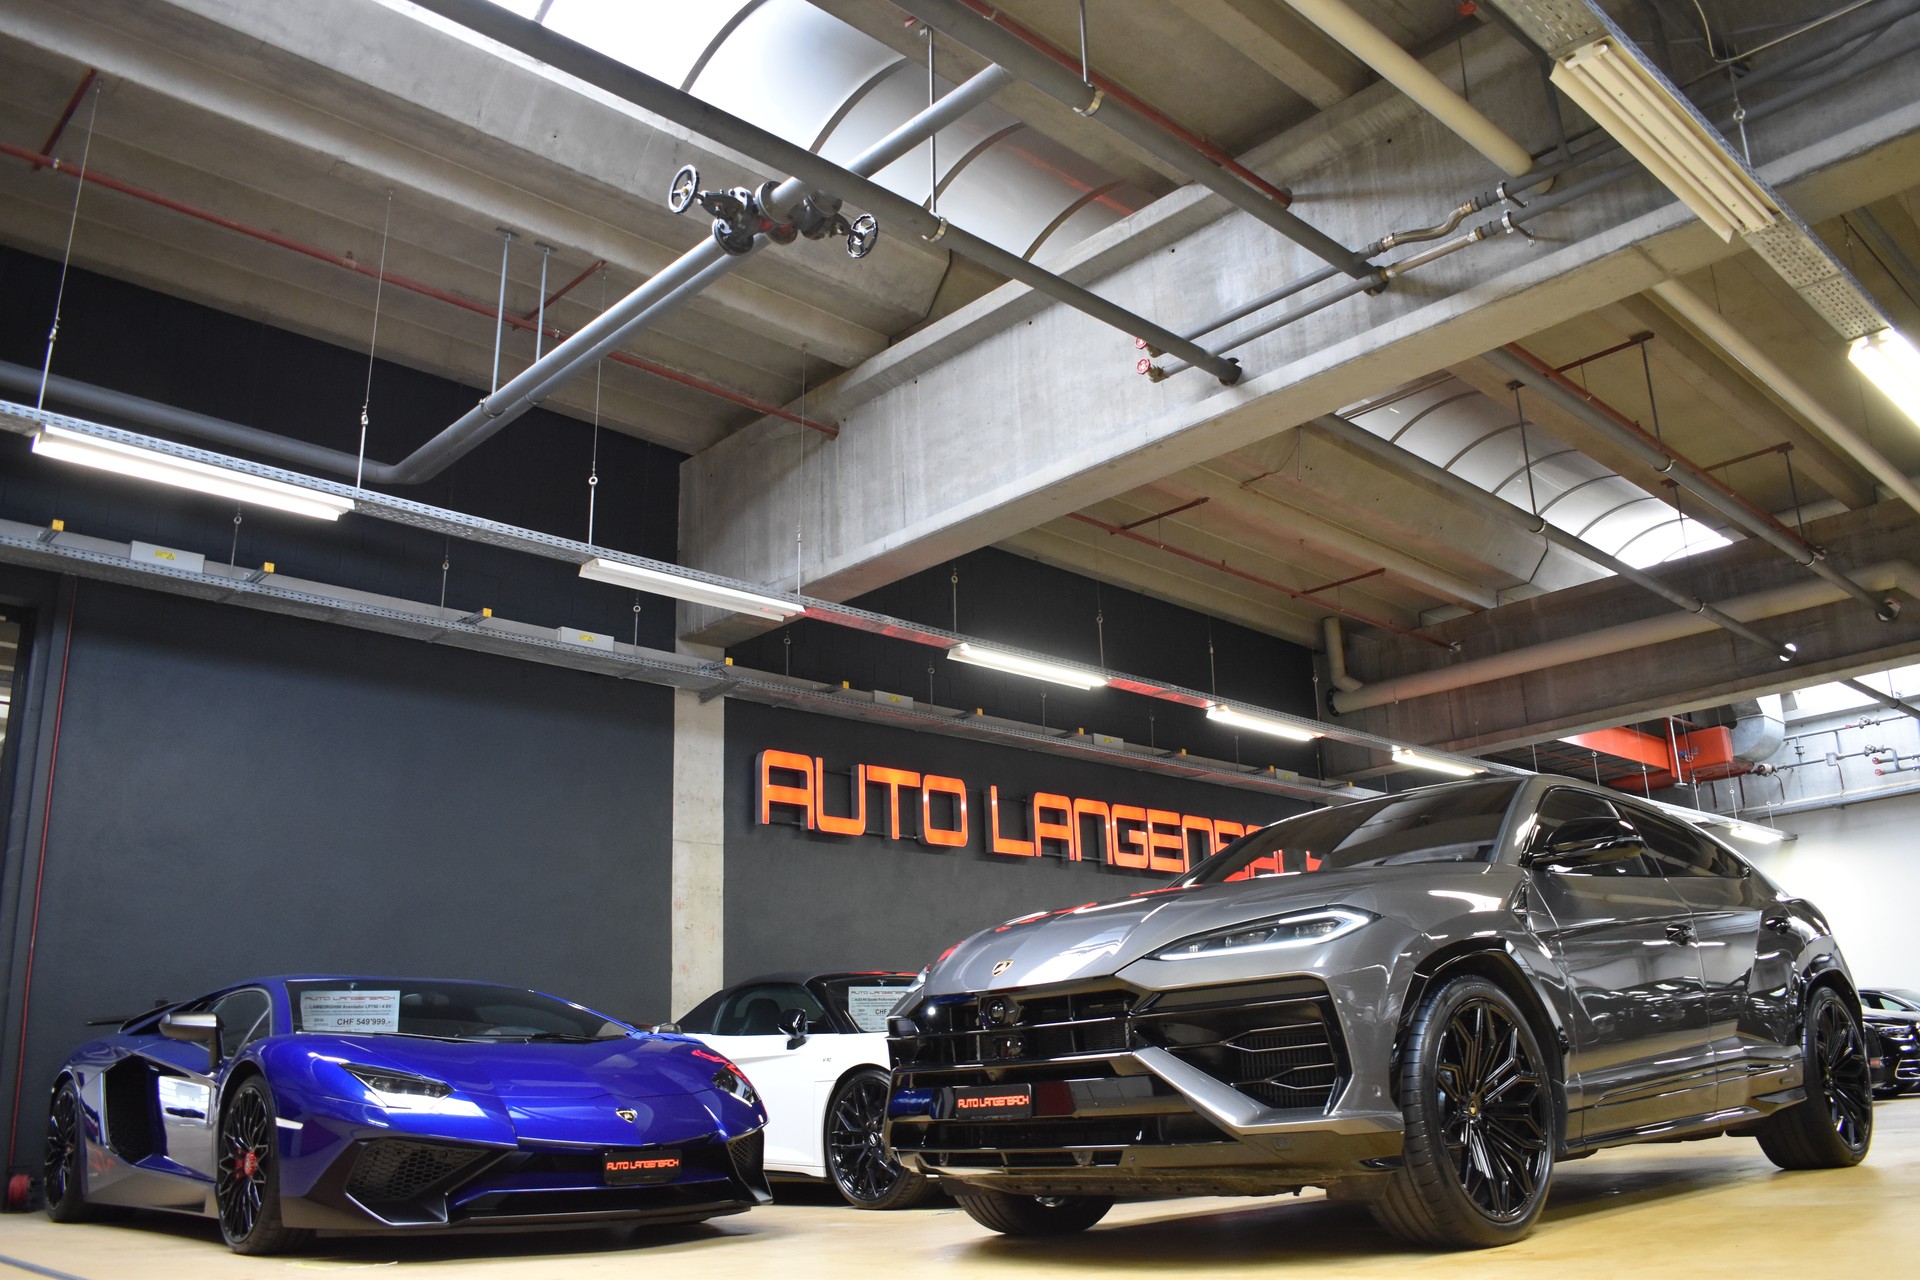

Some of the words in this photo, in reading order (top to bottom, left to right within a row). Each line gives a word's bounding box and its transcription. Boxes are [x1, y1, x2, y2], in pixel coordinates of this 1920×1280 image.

[755, 749, 968, 847] AUTO
[986, 785, 1322, 881] LANGENBA
[356, 1018, 391, 1026] 549'999.-
[958, 1098, 978, 1108] AUTO
[979, 1095, 1029, 1107] LANGENBACH
[606, 1161, 629, 1170] AUTO
[630, 1159, 679, 1169] LANGENBACH
